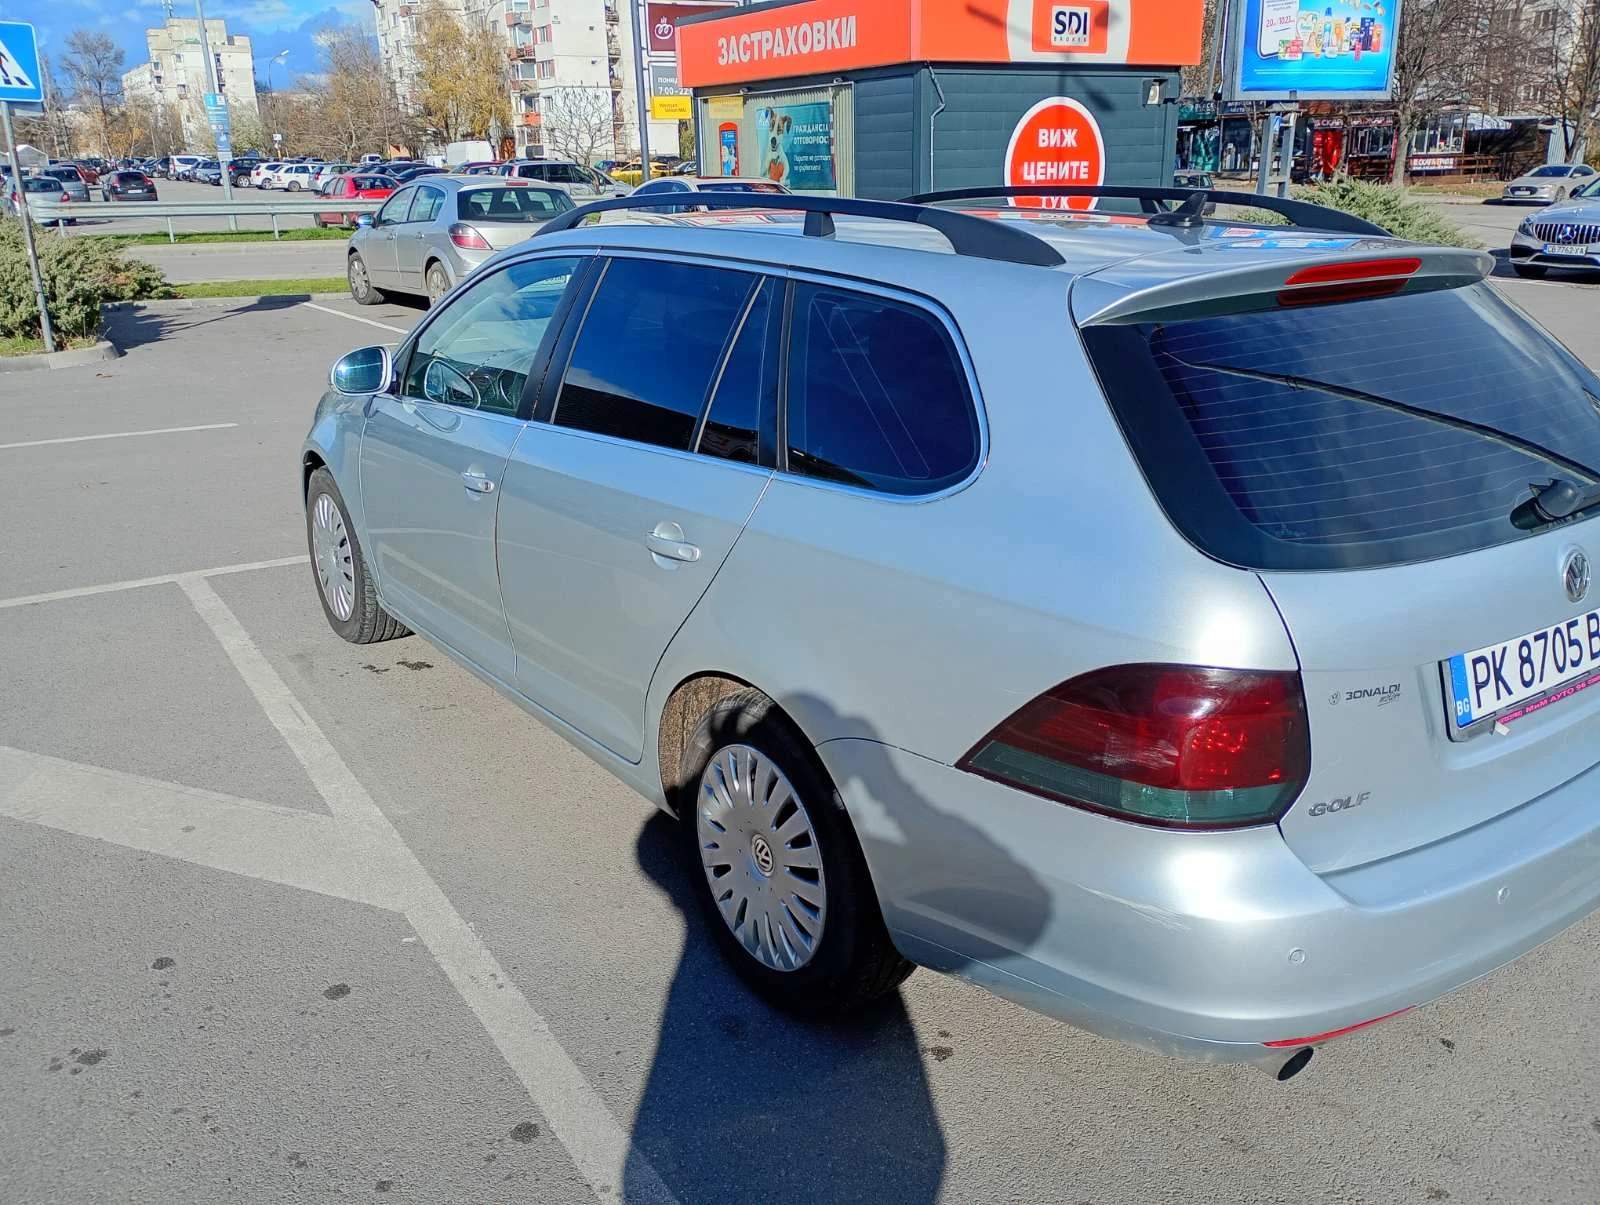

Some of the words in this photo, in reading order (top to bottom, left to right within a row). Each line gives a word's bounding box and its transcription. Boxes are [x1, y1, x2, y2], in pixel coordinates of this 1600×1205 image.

[1054, 10, 1088, 36] SDI
[718, 15, 857, 66] ЗАСТРАХОВКИ
[1038, 128, 1079, 148] ВИЖ
[1022, 161, 1090, 184] ЦЕНИТЕ
[1040, 196, 1070, 209] ТУК
[1471, 646, 1514, 709] PK
[1517, 619, 1584, 689] 8705
[1456, 698, 1470, 717] BG
[1308, 791, 1371, 817] GOLF
